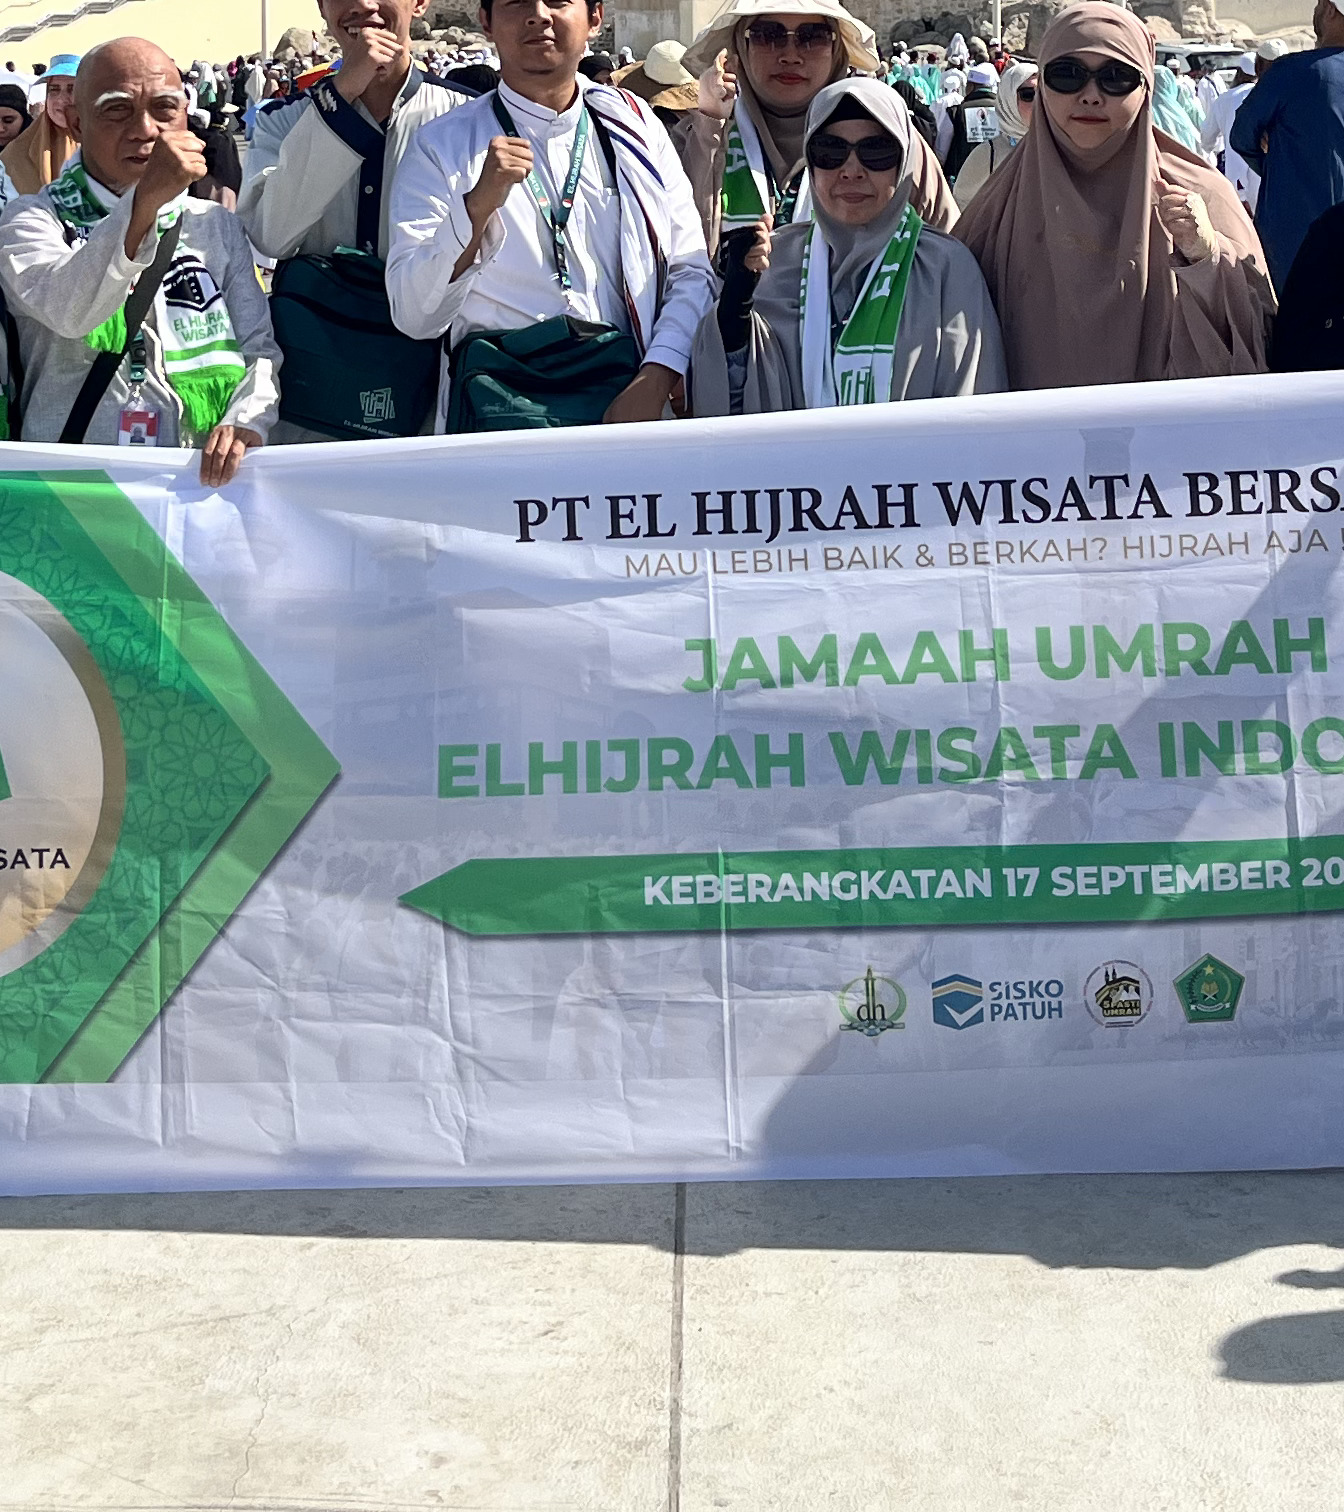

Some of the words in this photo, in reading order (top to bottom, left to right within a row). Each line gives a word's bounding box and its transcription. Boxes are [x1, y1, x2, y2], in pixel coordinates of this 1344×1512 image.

[173, 317, 186, 332] EL
[181, 324, 227, 343] WISATA
[513, 495, 590, 543] PT
[605, 493, 677, 540] EL
[690, 482, 921, 544] HIJRAH
[933, 472, 1173, 527] WISATA
[624, 552, 699, 578] MAU
[713, 547, 809, 575] LEBIH
[823, 544, 903, 571] BAIK
[915, 544, 935, 569] &
[948, 536, 1107, 568] BERKAH?
[1122, 530, 1250, 561] HIJRAH
[1263, 528, 1329, 555] AJA
[682, 626, 1011, 693] JAMAAH
[1035, 616, 1328, 681] UMRAH
[437, 731, 805, 798] ELHIJRAH
[827, 723, 1139, 788] WISATA
[643, 867, 993, 906] KEBERANGKATAN
[1000, 866, 1041, 898] 17
[1050, 859, 1291, 897] SEPTEMBER
[990, 1000, 1063, 1022] PATUH
